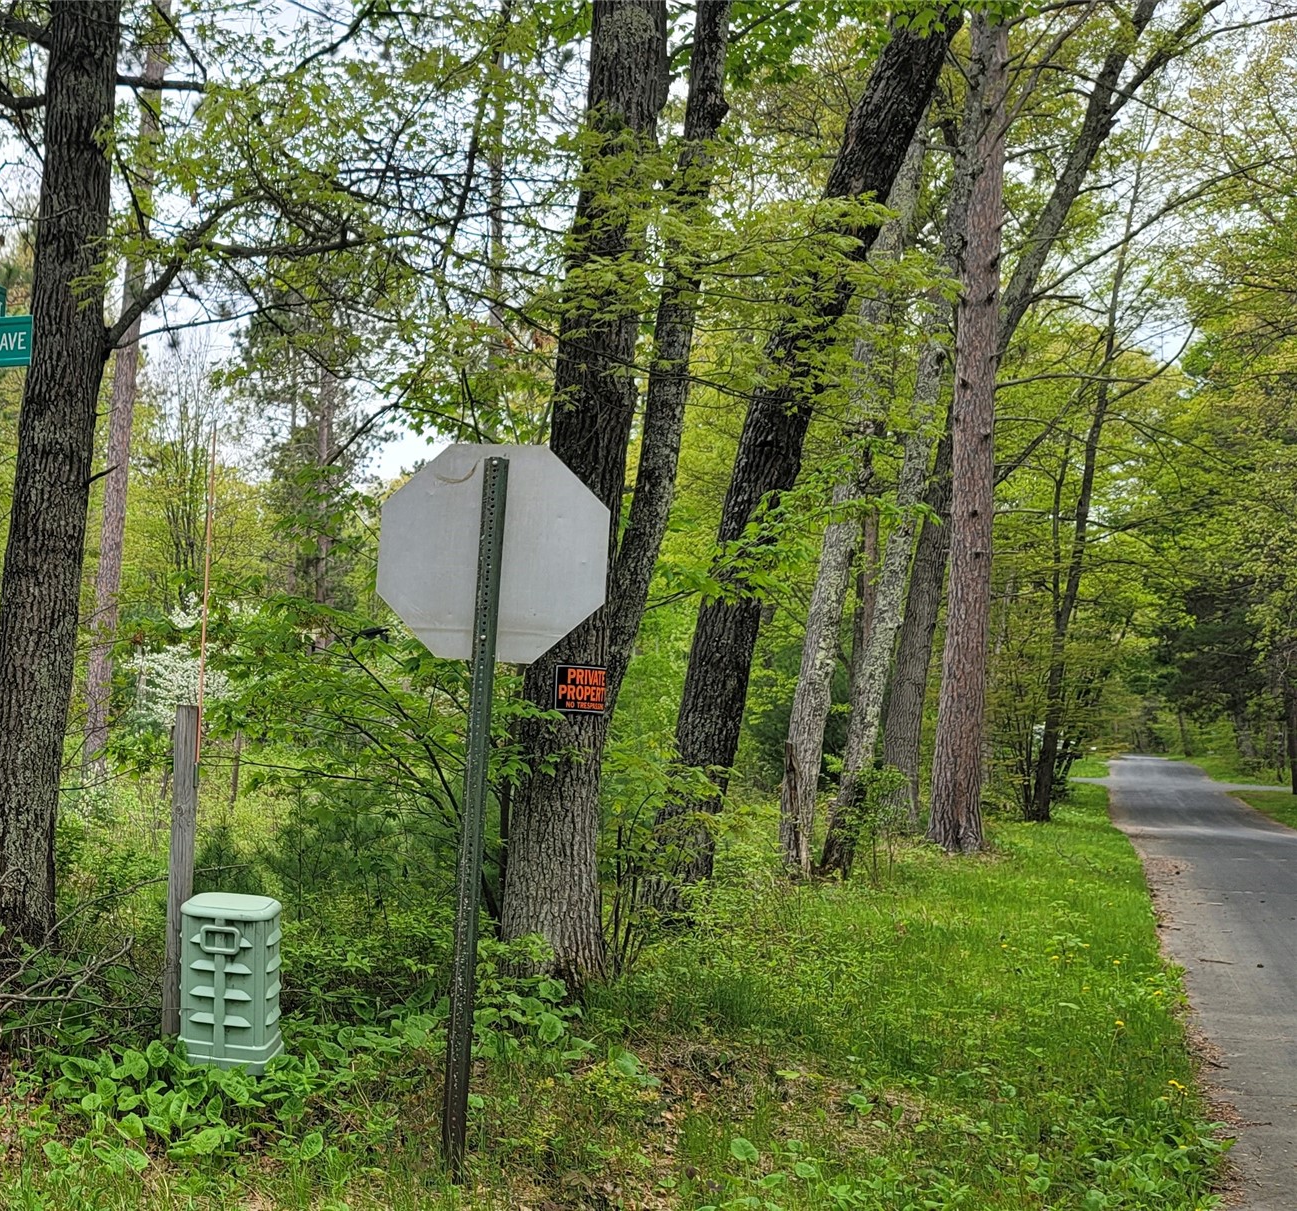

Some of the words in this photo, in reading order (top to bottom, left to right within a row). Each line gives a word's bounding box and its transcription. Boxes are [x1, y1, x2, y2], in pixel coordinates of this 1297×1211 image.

[0, 331, 27, 351] AVE
[567, 668, 606, 686] PRIVATE
[558, 684, 606, 702] PROPERT
